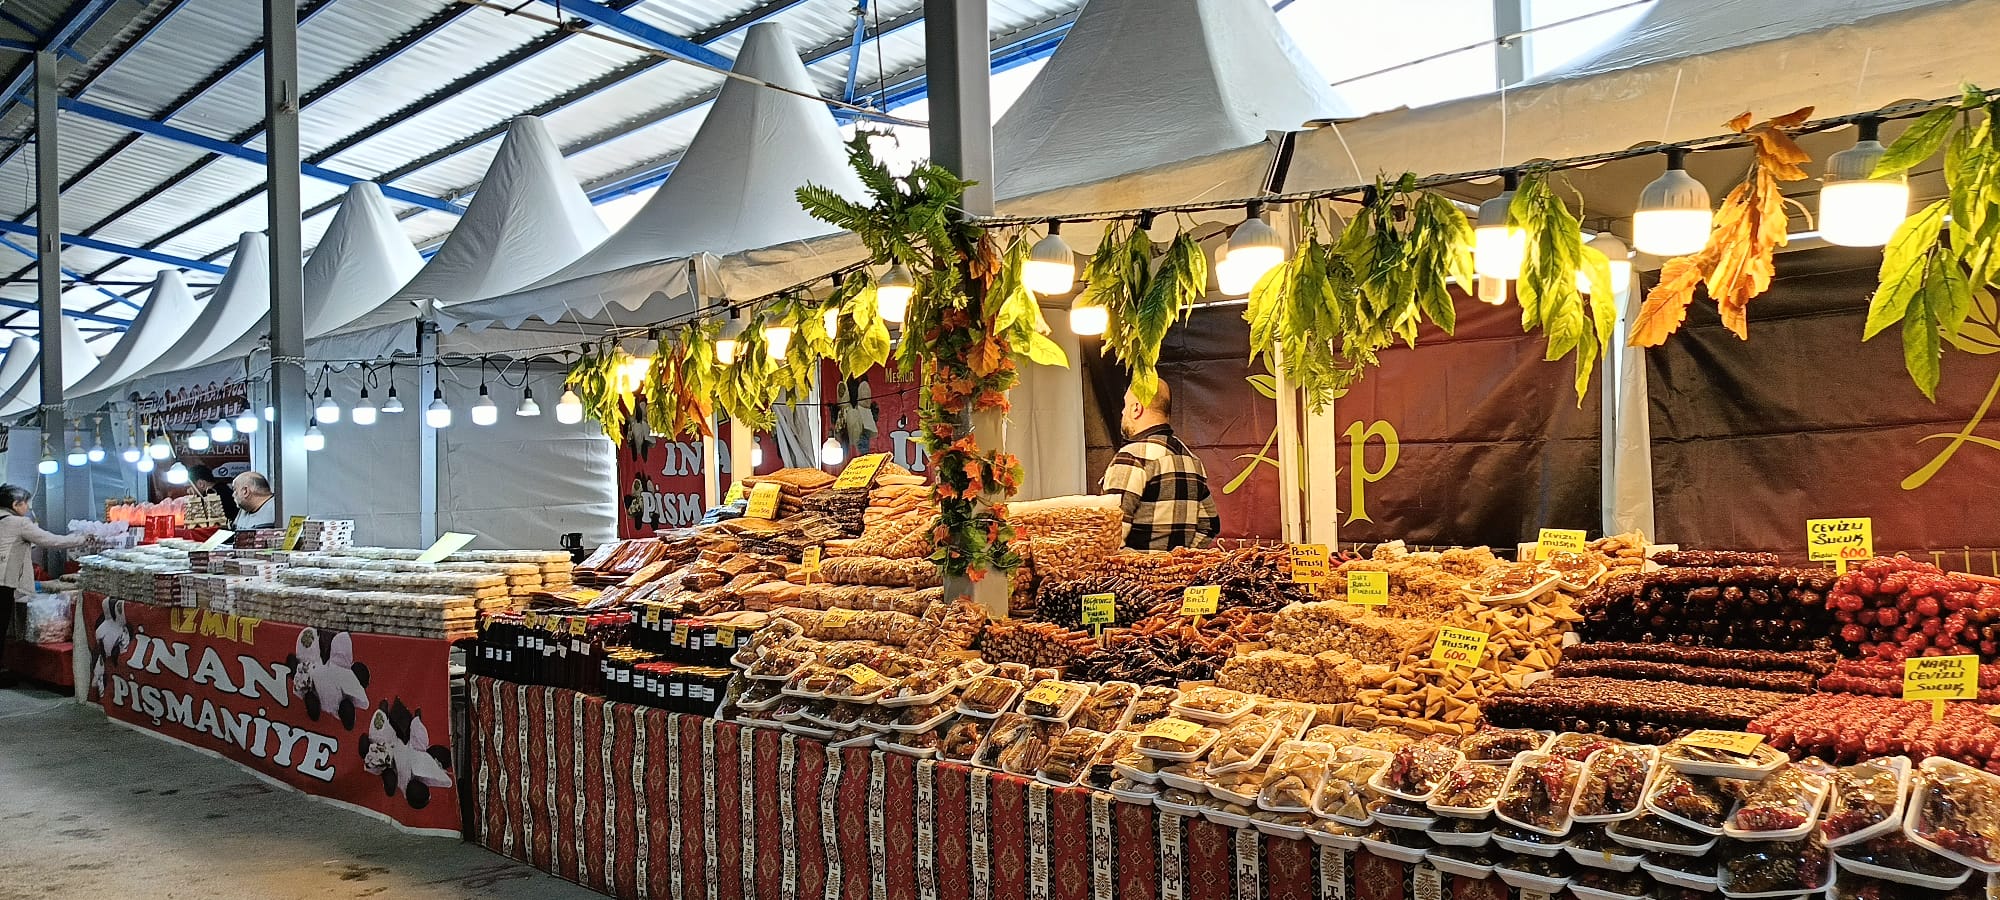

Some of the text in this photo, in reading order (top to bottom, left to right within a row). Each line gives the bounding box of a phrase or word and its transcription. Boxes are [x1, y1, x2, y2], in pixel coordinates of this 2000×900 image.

[1840, 546, 1867, 558] 600
[126, 624, 292, 708] İNAN
[1443, 648, 1467, 661] 600
[111, 672, 340, 783] PİŞMANİYE
